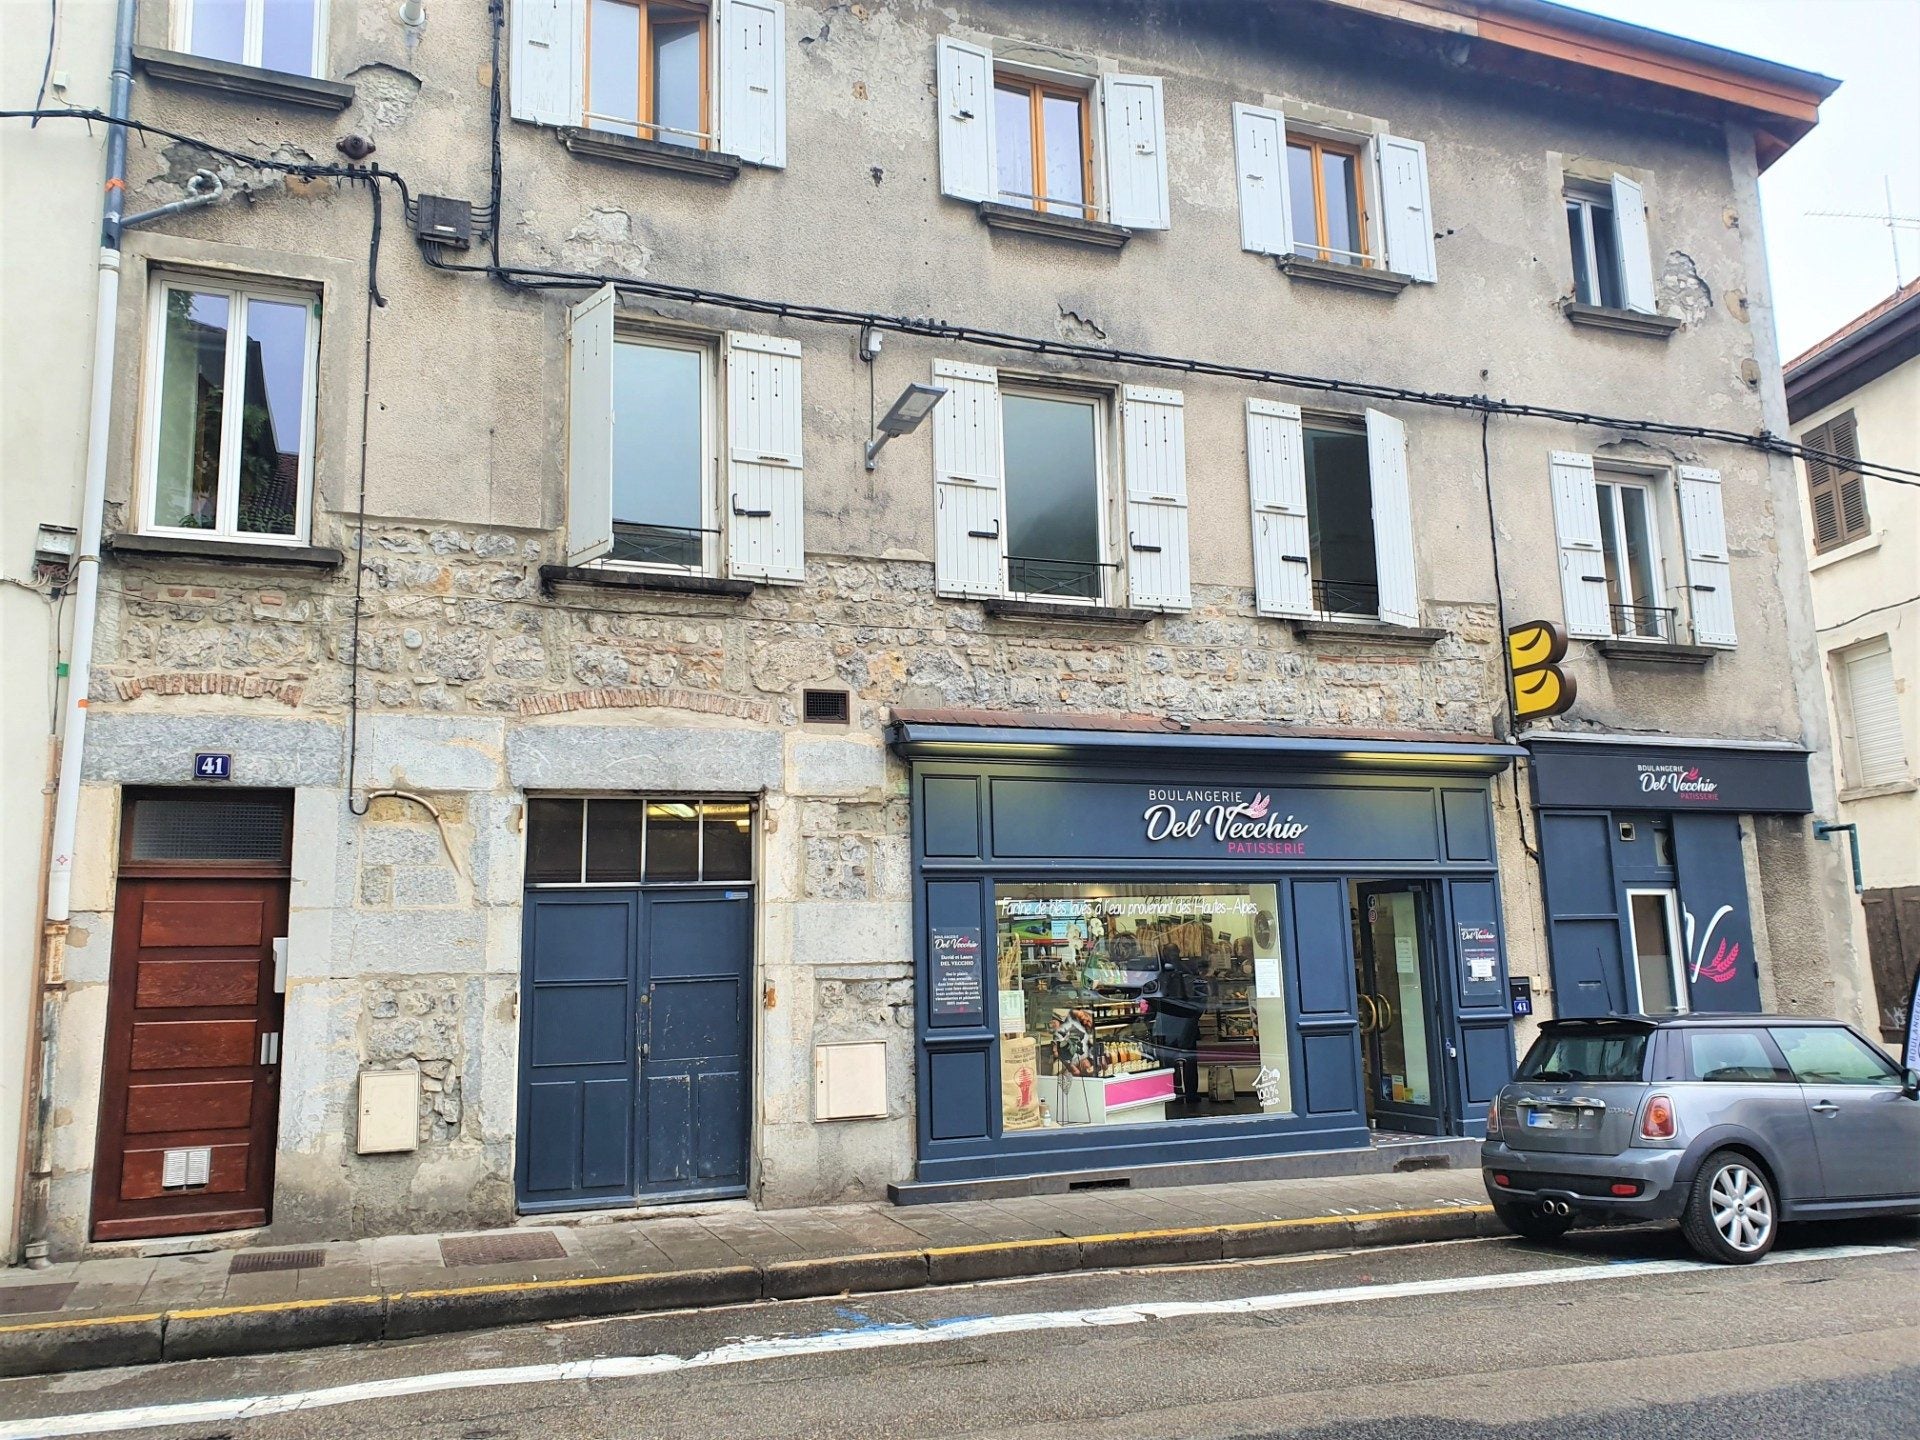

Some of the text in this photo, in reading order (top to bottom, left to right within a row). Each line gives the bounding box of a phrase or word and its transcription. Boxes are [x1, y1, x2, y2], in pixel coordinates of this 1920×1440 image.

[201, 757, 223, 774] 41
[1637, 764, 1684, 773] BOULANGERIE
[1639, 771, 1717, 793] Del Vecchio
[1149, 789, 1243, 803] BOULANGERIE
[1680, 792, 1719, 801] PATISSERIE
[1144, 802, 1309, 842] Del Vecchio
[1228, 842, 1306, 855] PATISSERIE
[1175, 898, 1191, 914] des
[934, 938, 950, 950] Del
[950, 937, 979, 949] Vecchio
[1517, 1002, 1527, 1011] 41
